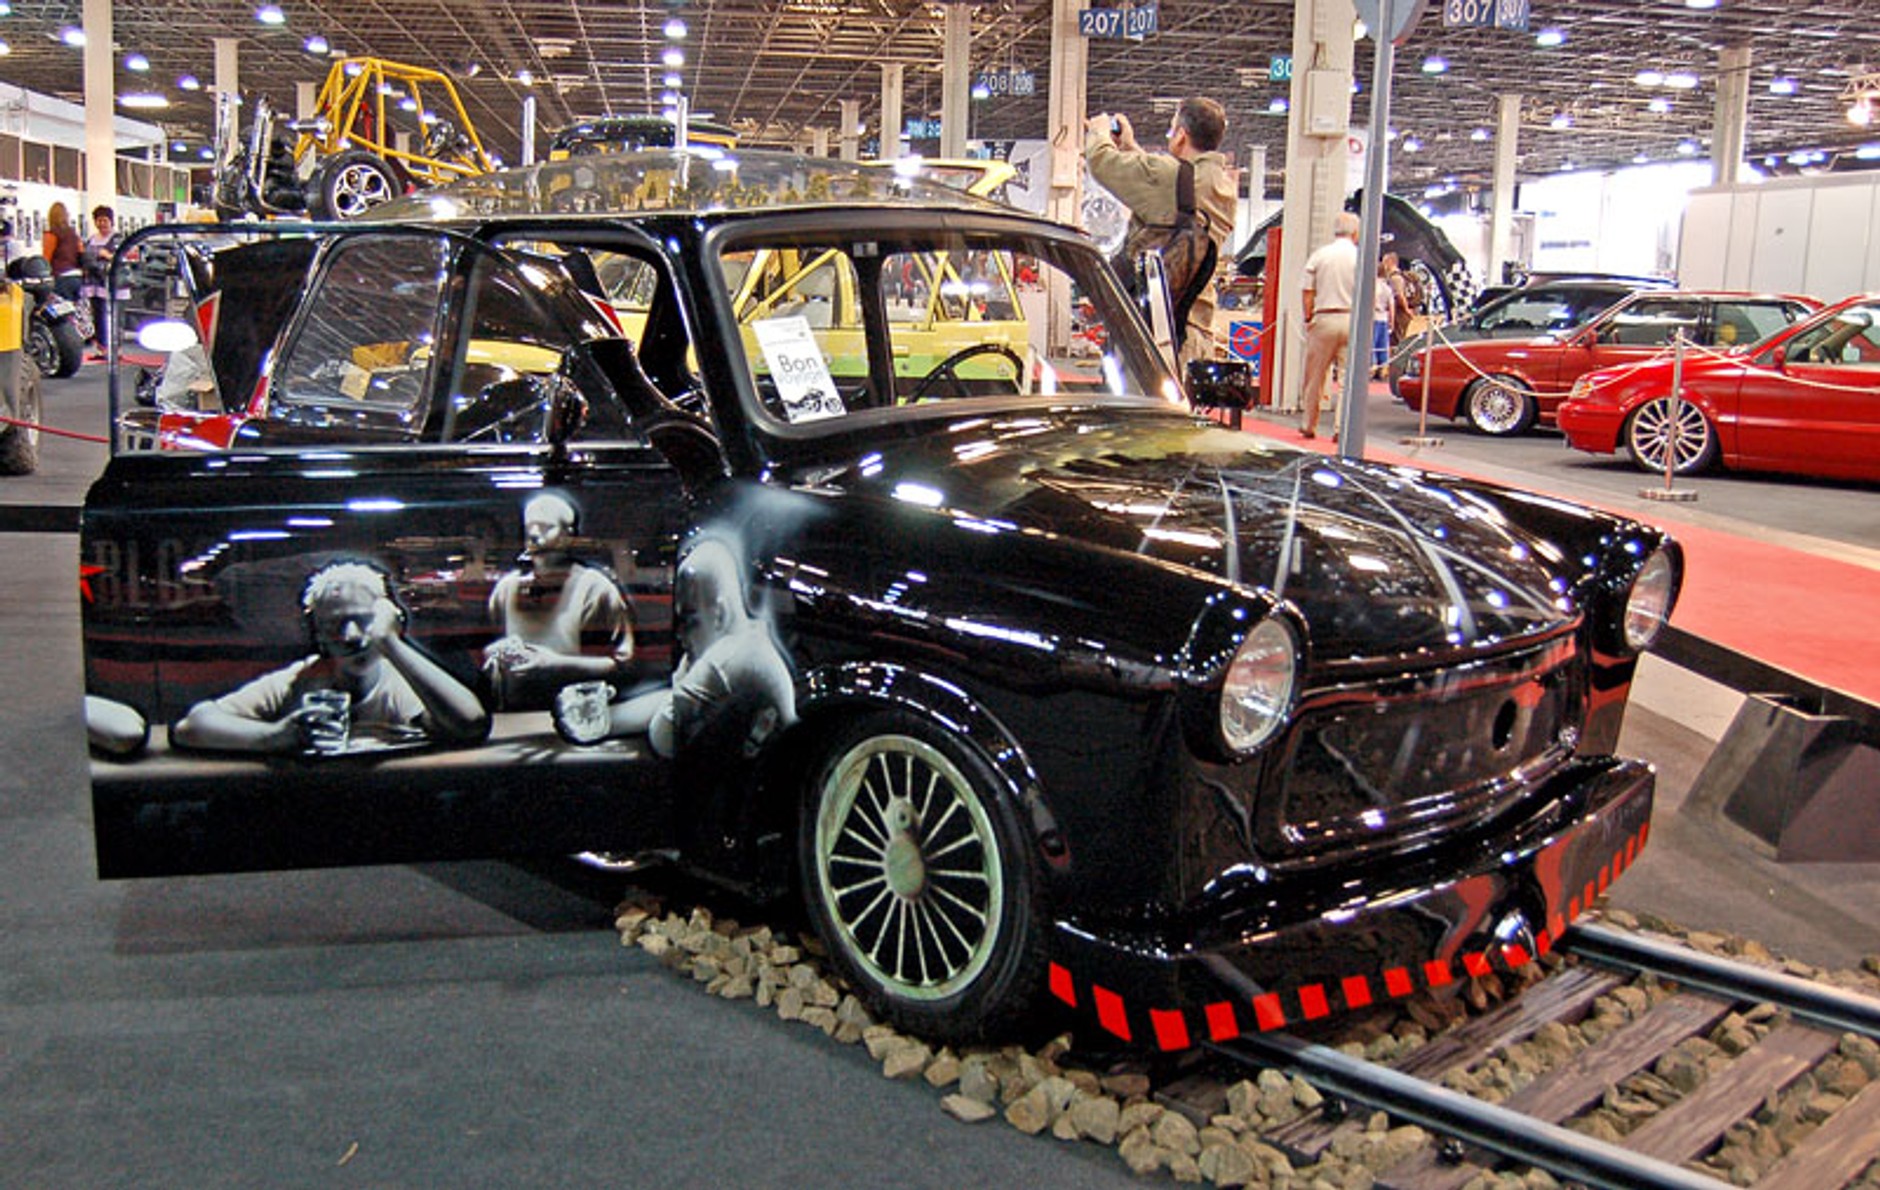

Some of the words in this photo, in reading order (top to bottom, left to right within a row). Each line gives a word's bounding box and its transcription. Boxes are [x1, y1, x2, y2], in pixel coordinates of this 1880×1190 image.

[1450, 0, 1492, 23] 307
[1083, 12, 1120, 38] 207
[1130, 9, 1154, 31] 207
[777, 354, 818, 373] Bon
